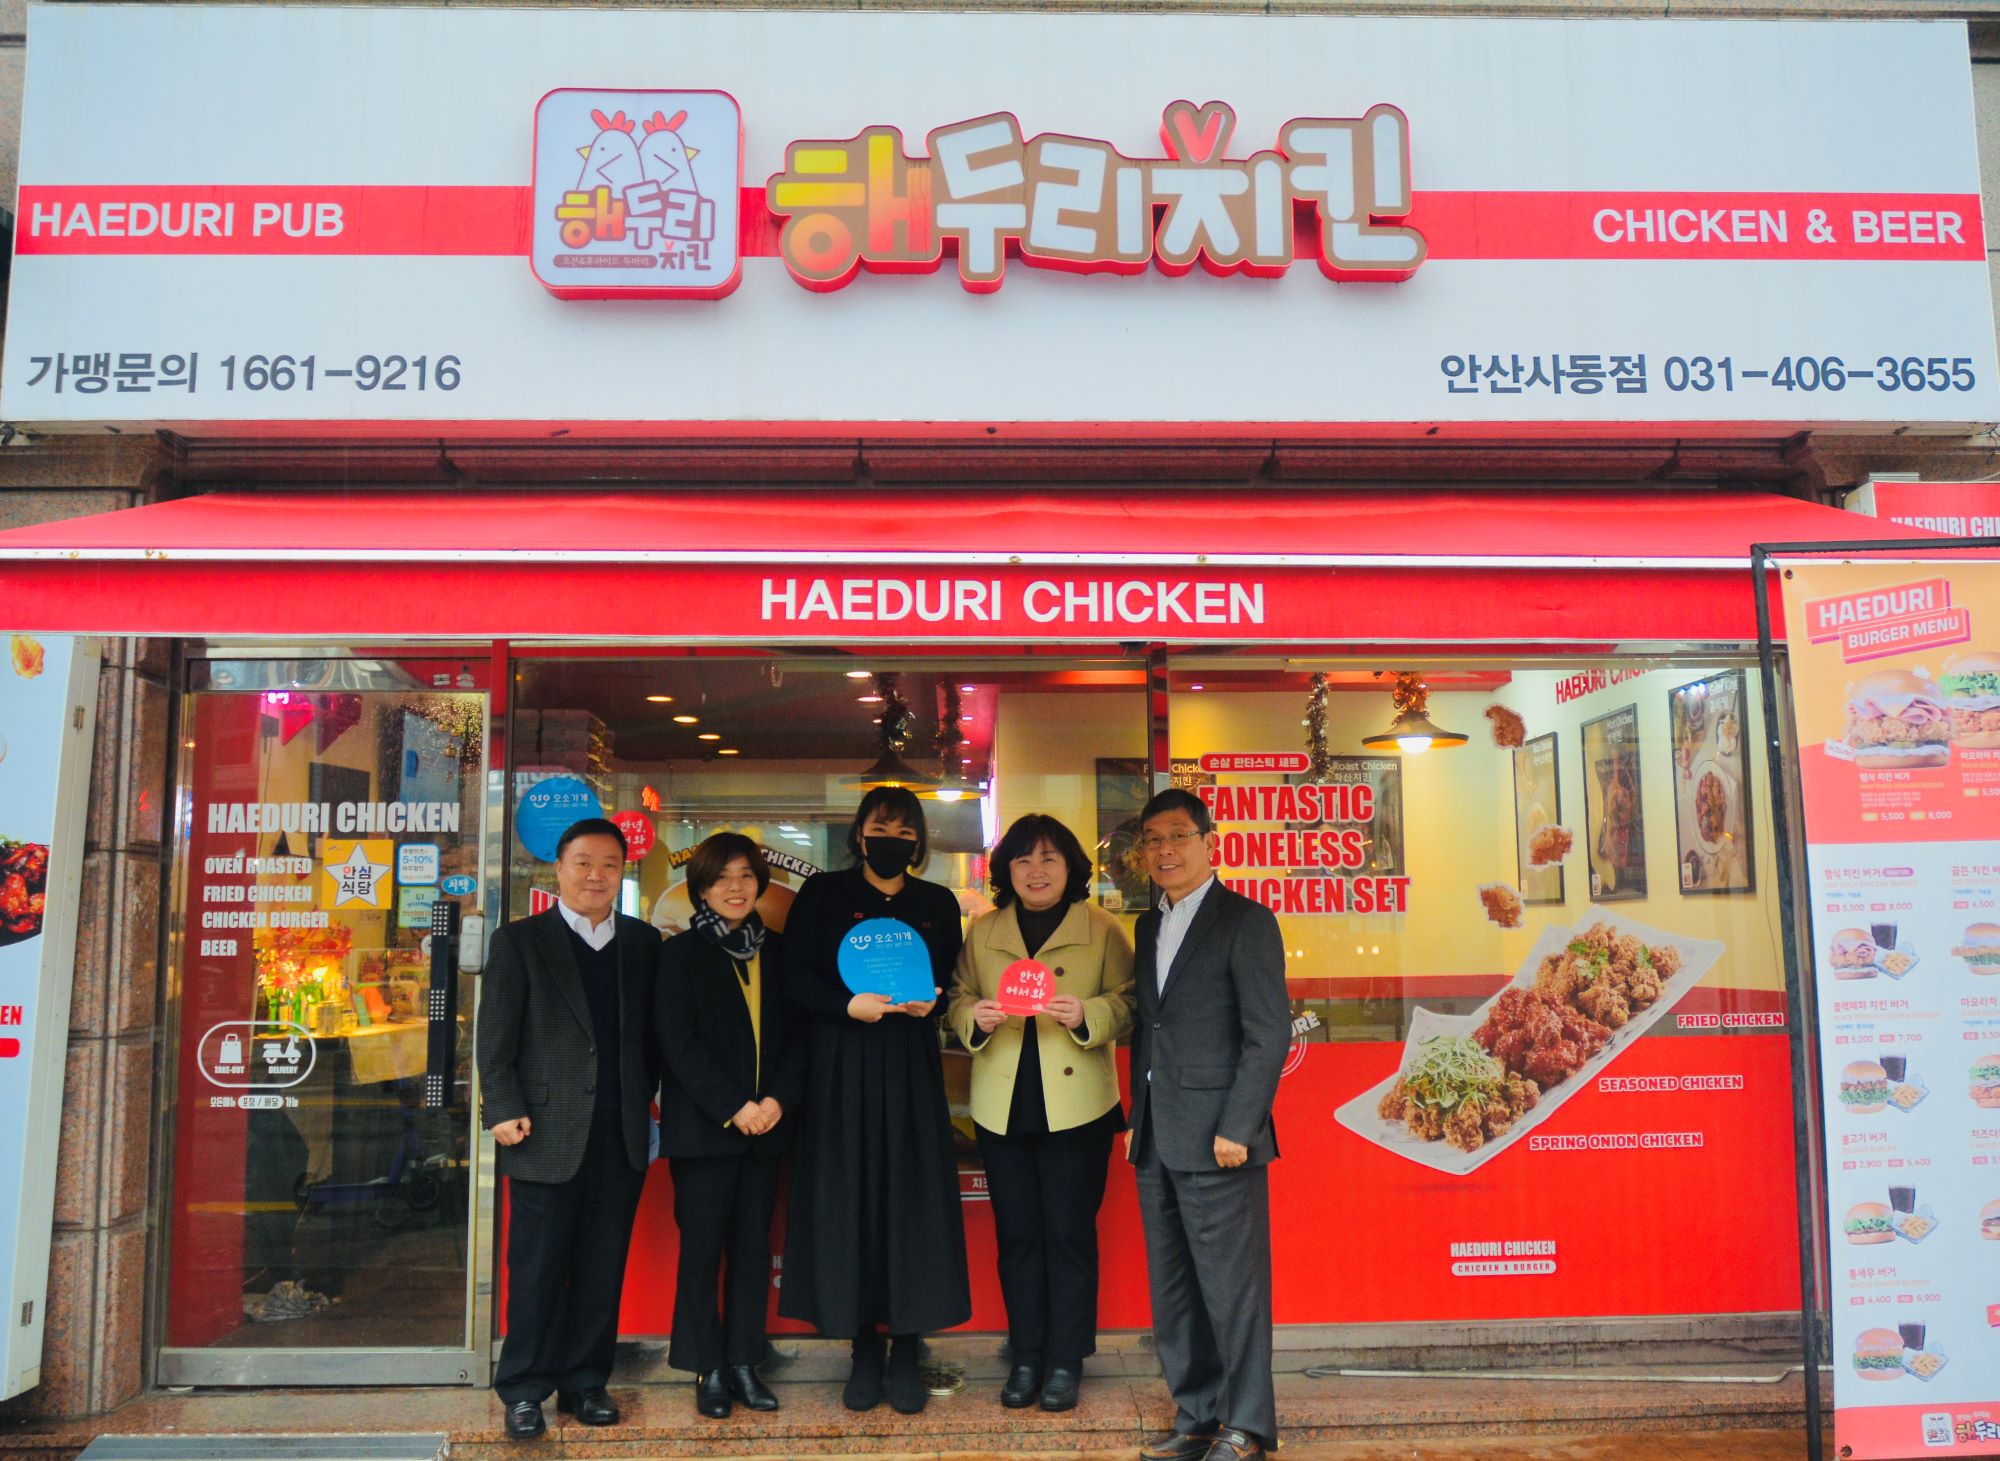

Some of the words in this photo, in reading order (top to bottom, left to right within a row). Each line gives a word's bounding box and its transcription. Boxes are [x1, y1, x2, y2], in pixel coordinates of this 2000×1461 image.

[772, 104, 1422, 280] 해두리치킨
[31, 203, 234, 238] HAEDURI
[252, 203, 344, 237] PUB
[554, 180, 715, 249] 해두리
[1593, 208, 1788, 243] CHICKEN
[1806, 208, 1837, 243] &
[1852, 210, 1965, 244] BEER
[659, 241, 712, 271] 치킨
[26, 352, 198, 394] 가맹문의
[219, 354, 462, 392] 1661-9216
[1440, 354, 1648, 394] 안산사동점
[1664, 356, 1976, 393] 031-406-3655
[1890, 517, 1967, 537] EDURI
[761, 579, 1001, 621] HAEDURI
[1023, 580, 1265, 623] CHICKEN
[1819, 586, 1934, 628] HAEDURI
[1848, 624, 1910, 649] BURGER
[1913, 616, 1959, 638] MENU
[1210, 757, 1231, 768] 순살
[1234, 757, 1275, 768] 판타스틱
[1279, 757, 1300, 768] 세트
[1361, 761, 1398, 771] Chicken
[553, 793, 589, 802] 오소가게
[1198, 785, 1375, 822] FANTASTIC
[207, 802, 330, 833] HAEDURI
[337, 801, 460, 833] CHICKEN
[204, 857, 243, 874] OVEN
[246, 857, 313, 874] ROASTED
[342, 865, 372, 881] 안심
[203, 886, 245, 902] FRIED
[248, 886, 313, 902] CHICKEN
[341, 881, 372, 895] 식당
[1224, 878, 1344, 913] ICKEN
[1353, 876, 1411, 913] SET
[202, 912, 266, 928] CHICKEN
[270, 912, 329, 928] BURGER
[875, 931, 912, 943] 오소가게
[200, 940, 238, 956] BEER
[1019, 970, 1048, 988] 안녕,
[1677, 1014, 1720, 1028] FRIED
[1722, 1013, 1784, 1028] CHICKEN
[268, 1066, 299, 1074] DELIVERY
[1599, 1076, 1679, 1092] SEASONED
[1681, 1075, 1744, 1091] CHICKEN
[1529, 1135, 1587, 1151] SPRING
[1589, 1134, 1638, 1150] ONION
[1641, 1132, 1703, 1148] CHICKEN
[1450, 1242, 1501, 1257] HAEDURI
[1504, 1241, 1556, 1256] CHICKEN
[1457, 1263, 1500, 1272] CHICKEN
[1513, 1262, 1551, 1271] BURGER
